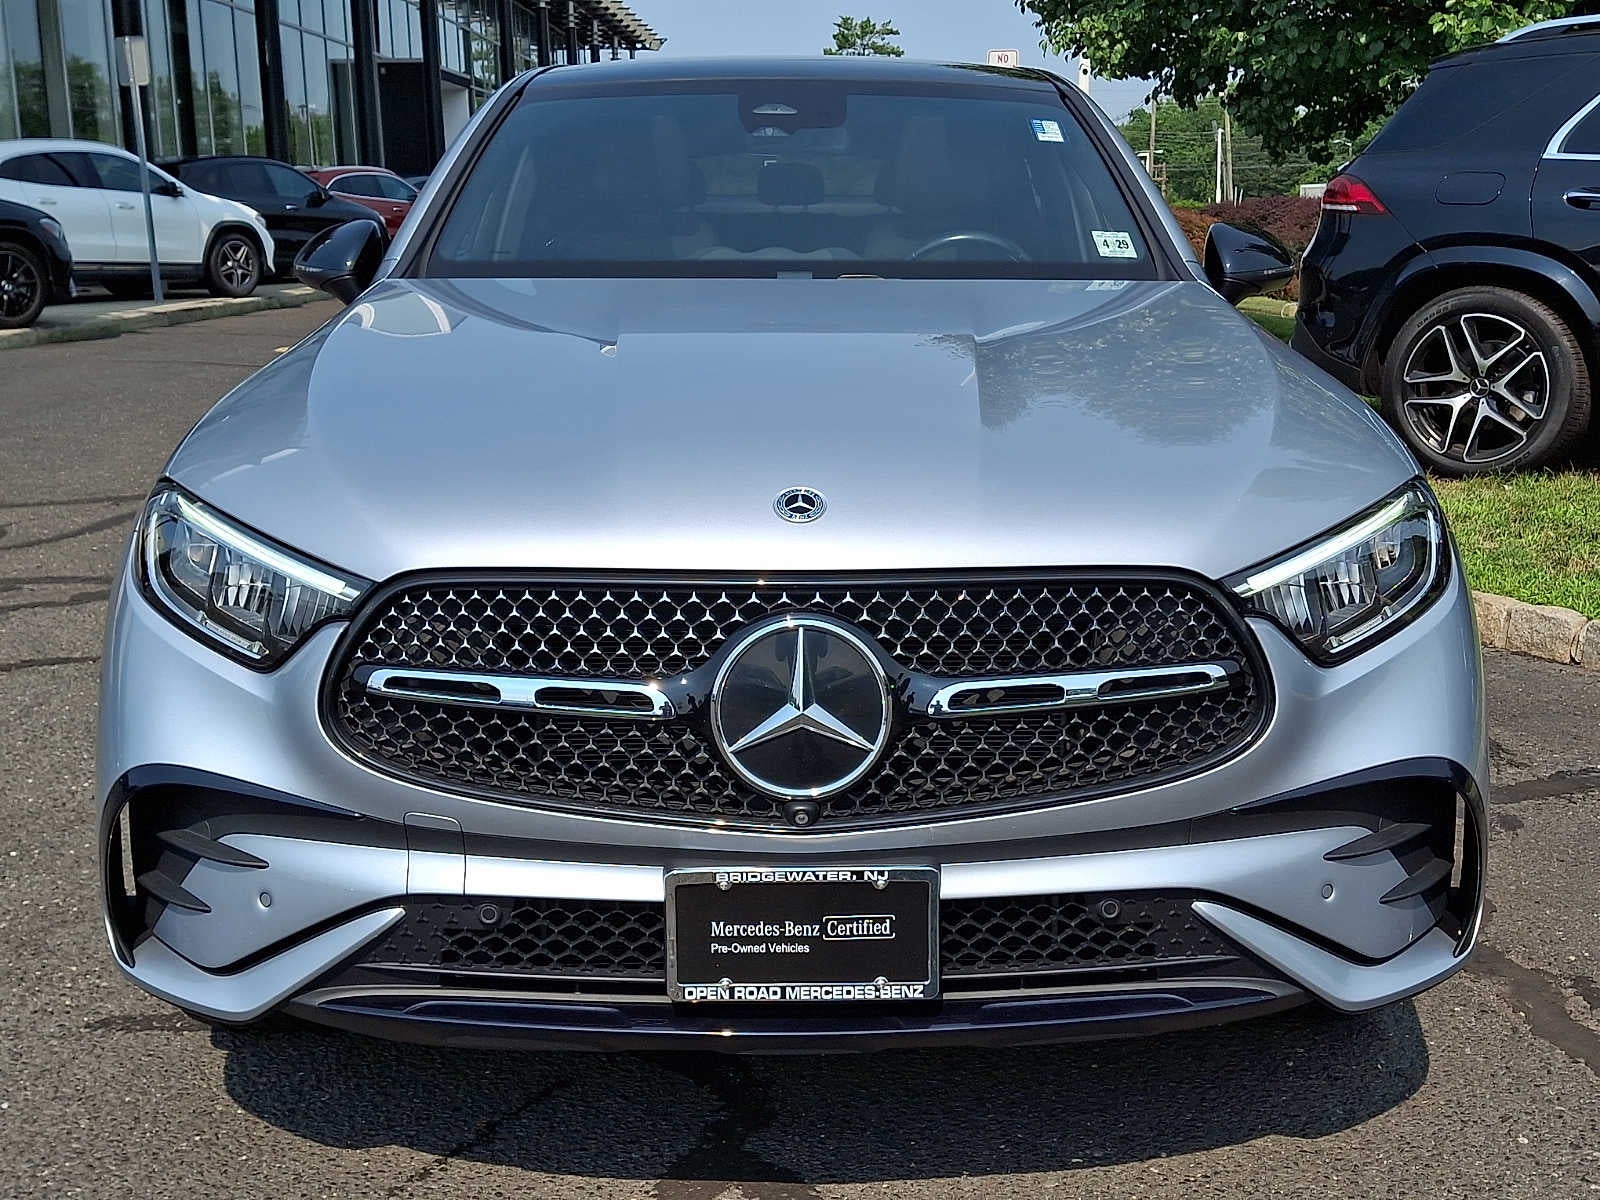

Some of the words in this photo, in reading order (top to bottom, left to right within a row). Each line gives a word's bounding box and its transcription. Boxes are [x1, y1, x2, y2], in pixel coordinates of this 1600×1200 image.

[997, 54, 1009, 64] NO
[1102, 239, 1110, 249] 4
[1115, 239, 1129, 249] 29
[715, 871, 857, 882] BRIDGEWATER,
[864, 870, 889, 882] NJ
[711, 921, 820, 937] Mercedes-Benz
[827, 919, 890, 936] Certified
[711, 943, 766, 954] Pre-Owned
[769, 943, 810, 954] Vehicles
[684, 986, 729, 1000] OPEN
[734, 986, 780, 1000] ROAD
[785, 985, 924, 1000] MERCEDES-BENZ
